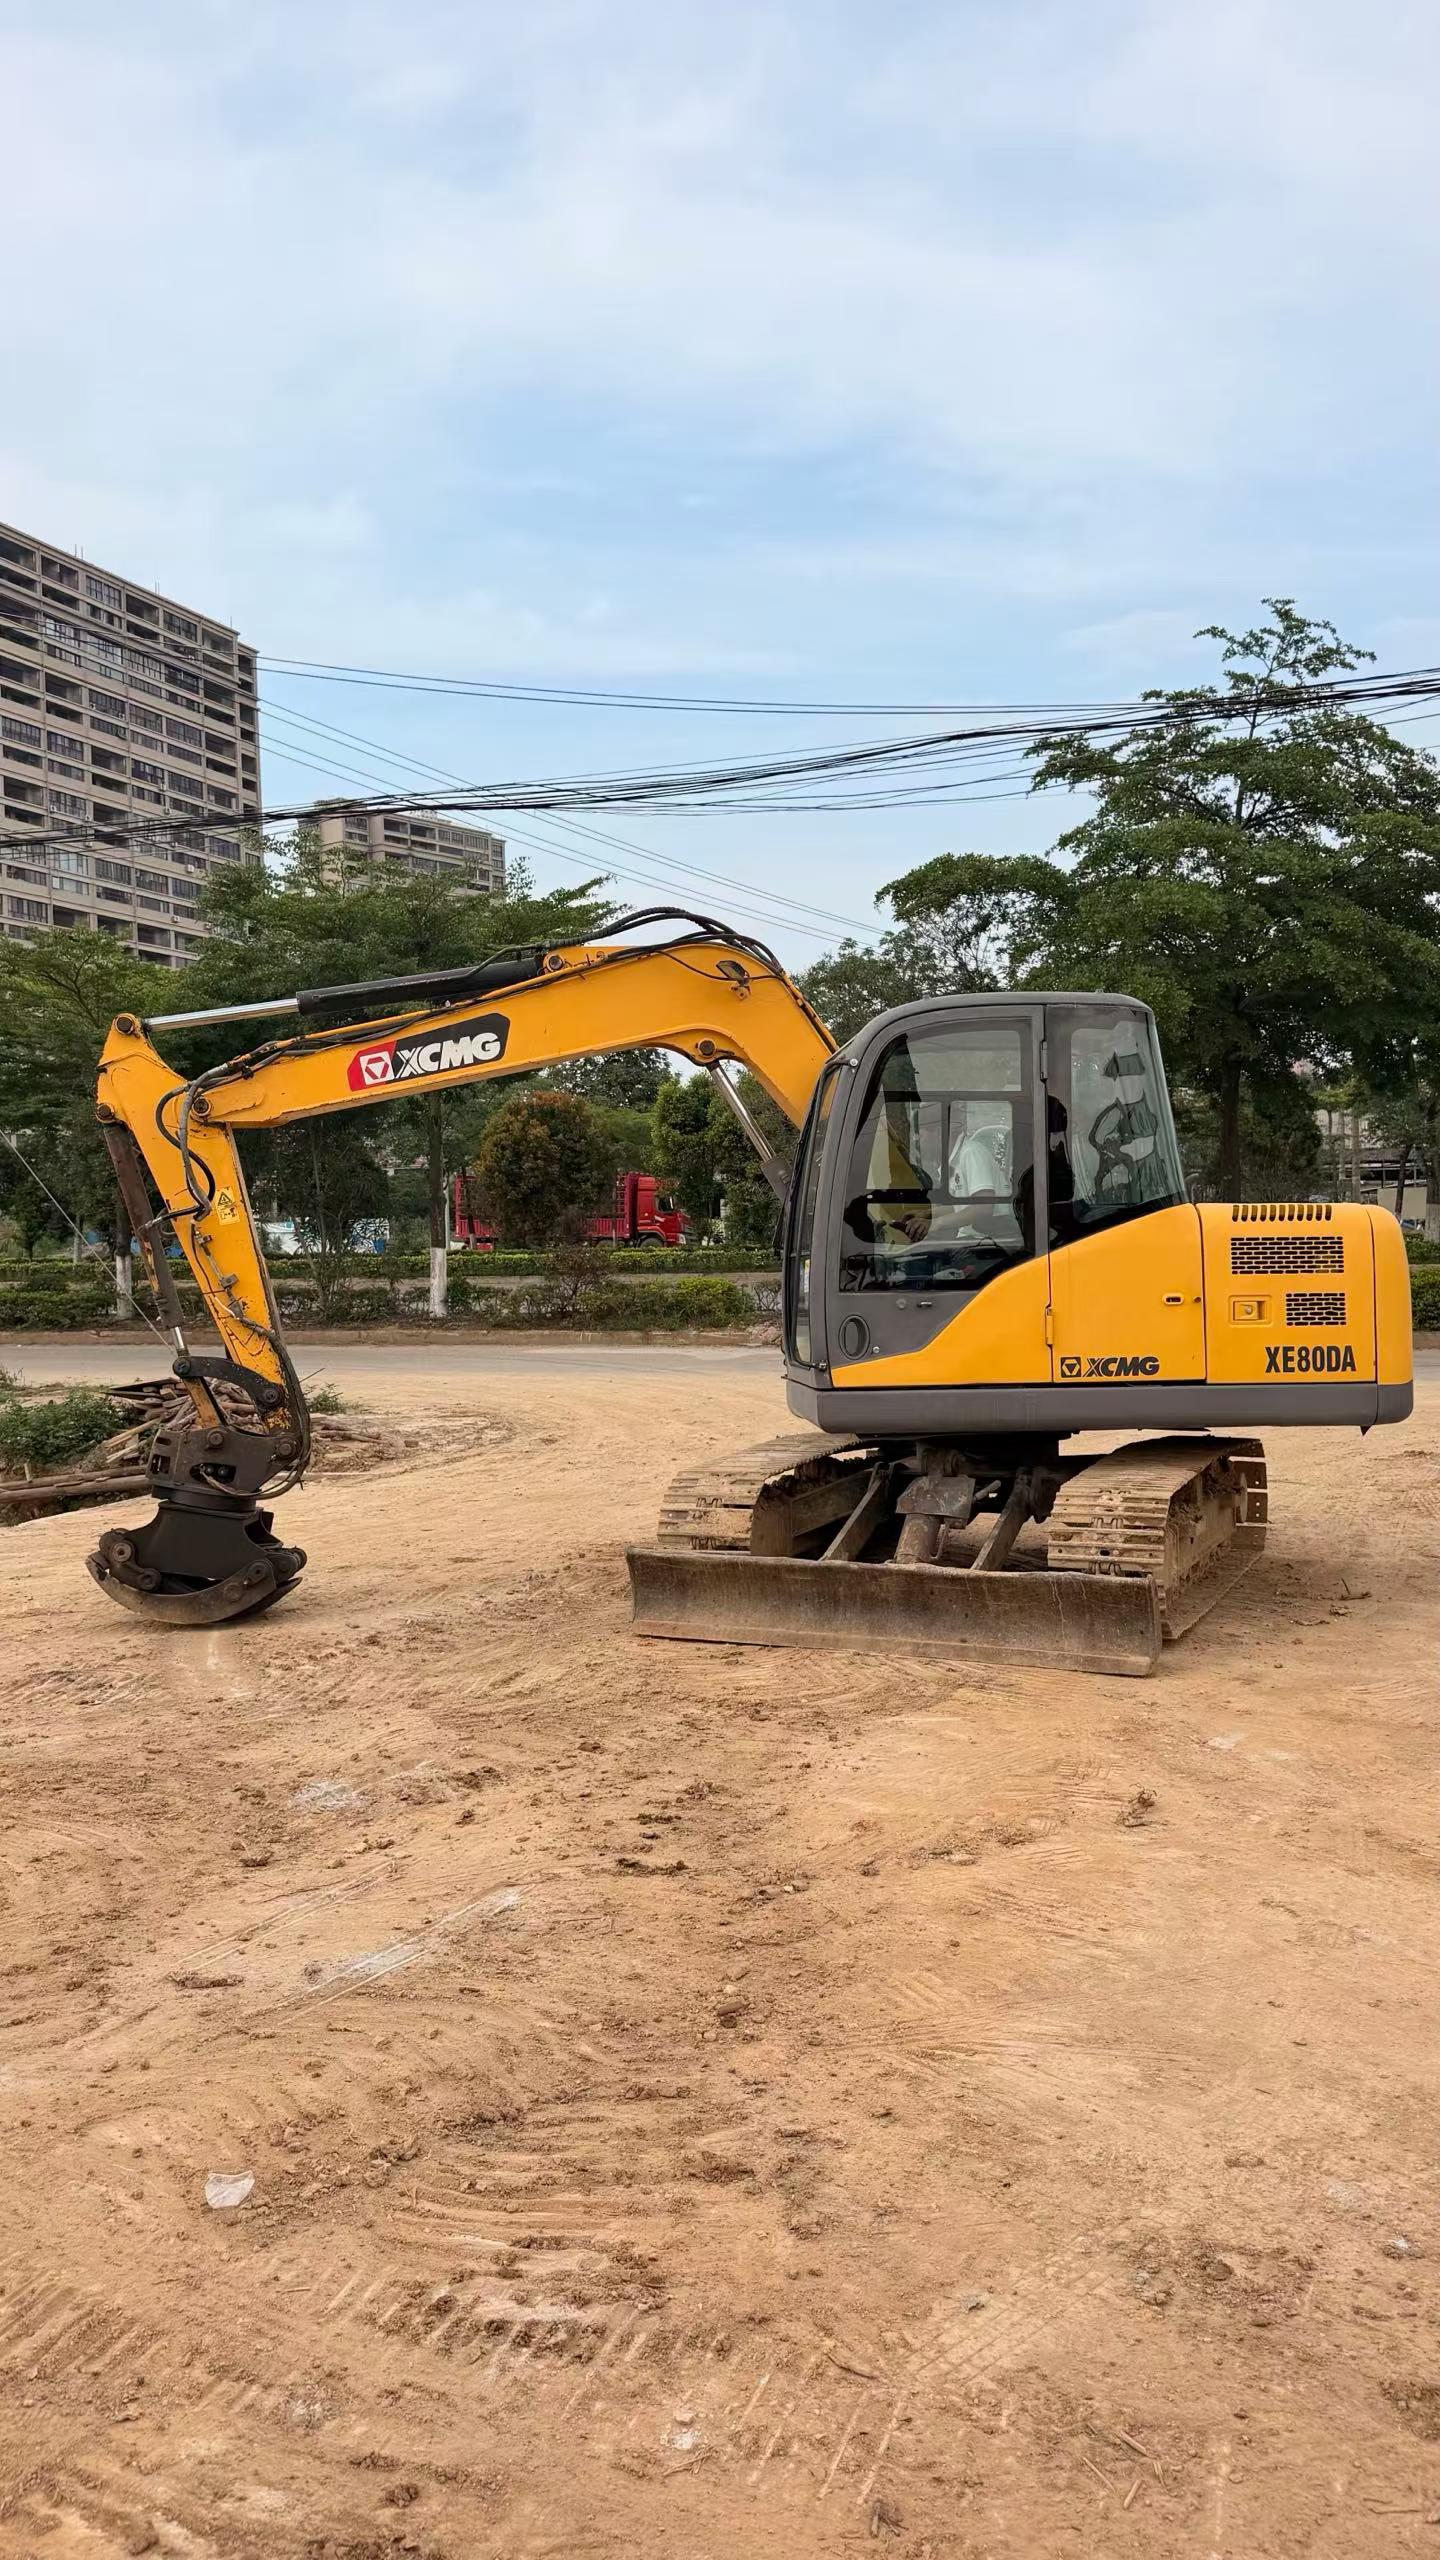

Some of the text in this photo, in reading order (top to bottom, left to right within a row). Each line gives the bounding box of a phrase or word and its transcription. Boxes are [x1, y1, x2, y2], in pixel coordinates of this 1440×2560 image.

[395, 1032, 501, 1079] XCMG
[1083, 1356, 1160, 1378] XCMG
[1264, 1345, 1357, 1373] XE80DA
